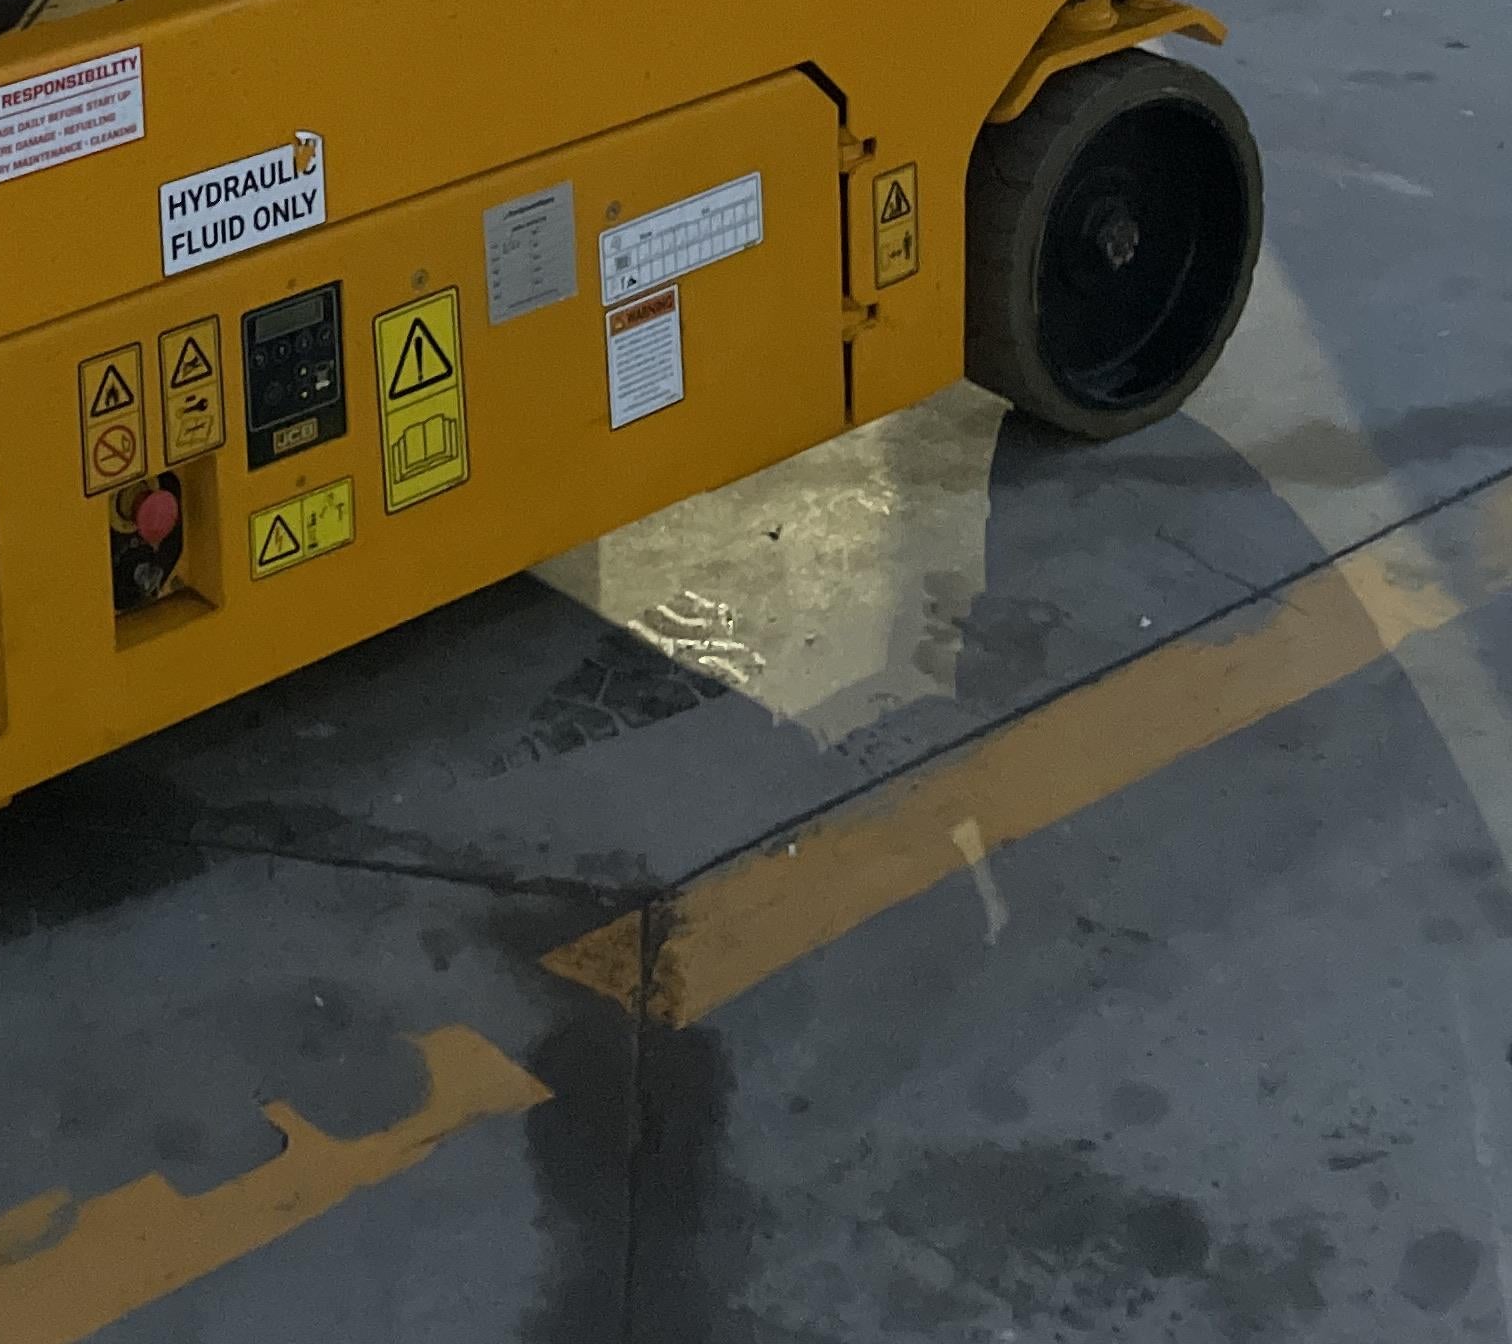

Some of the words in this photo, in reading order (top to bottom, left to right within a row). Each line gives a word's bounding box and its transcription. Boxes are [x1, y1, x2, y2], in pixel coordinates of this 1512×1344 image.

[1, 56, 138, 109] RESPONSIBILITY
[15, 130, 56, 151] DAMAGE
[63, 112, 117, 137] REFUELING
[18, 116, 46, 133] DAILY
[47, 104, 84, 123] BEFORE
[86, 94, 115, 111] START
[117, 89, 132, 102] UP
[13, 141, 83, 170] MAINTENANCE
[90, 123, 138, 147] CLEANING
[171, 214, 245, 261] FLUID
[253, 188, 317, 232] ONLY
